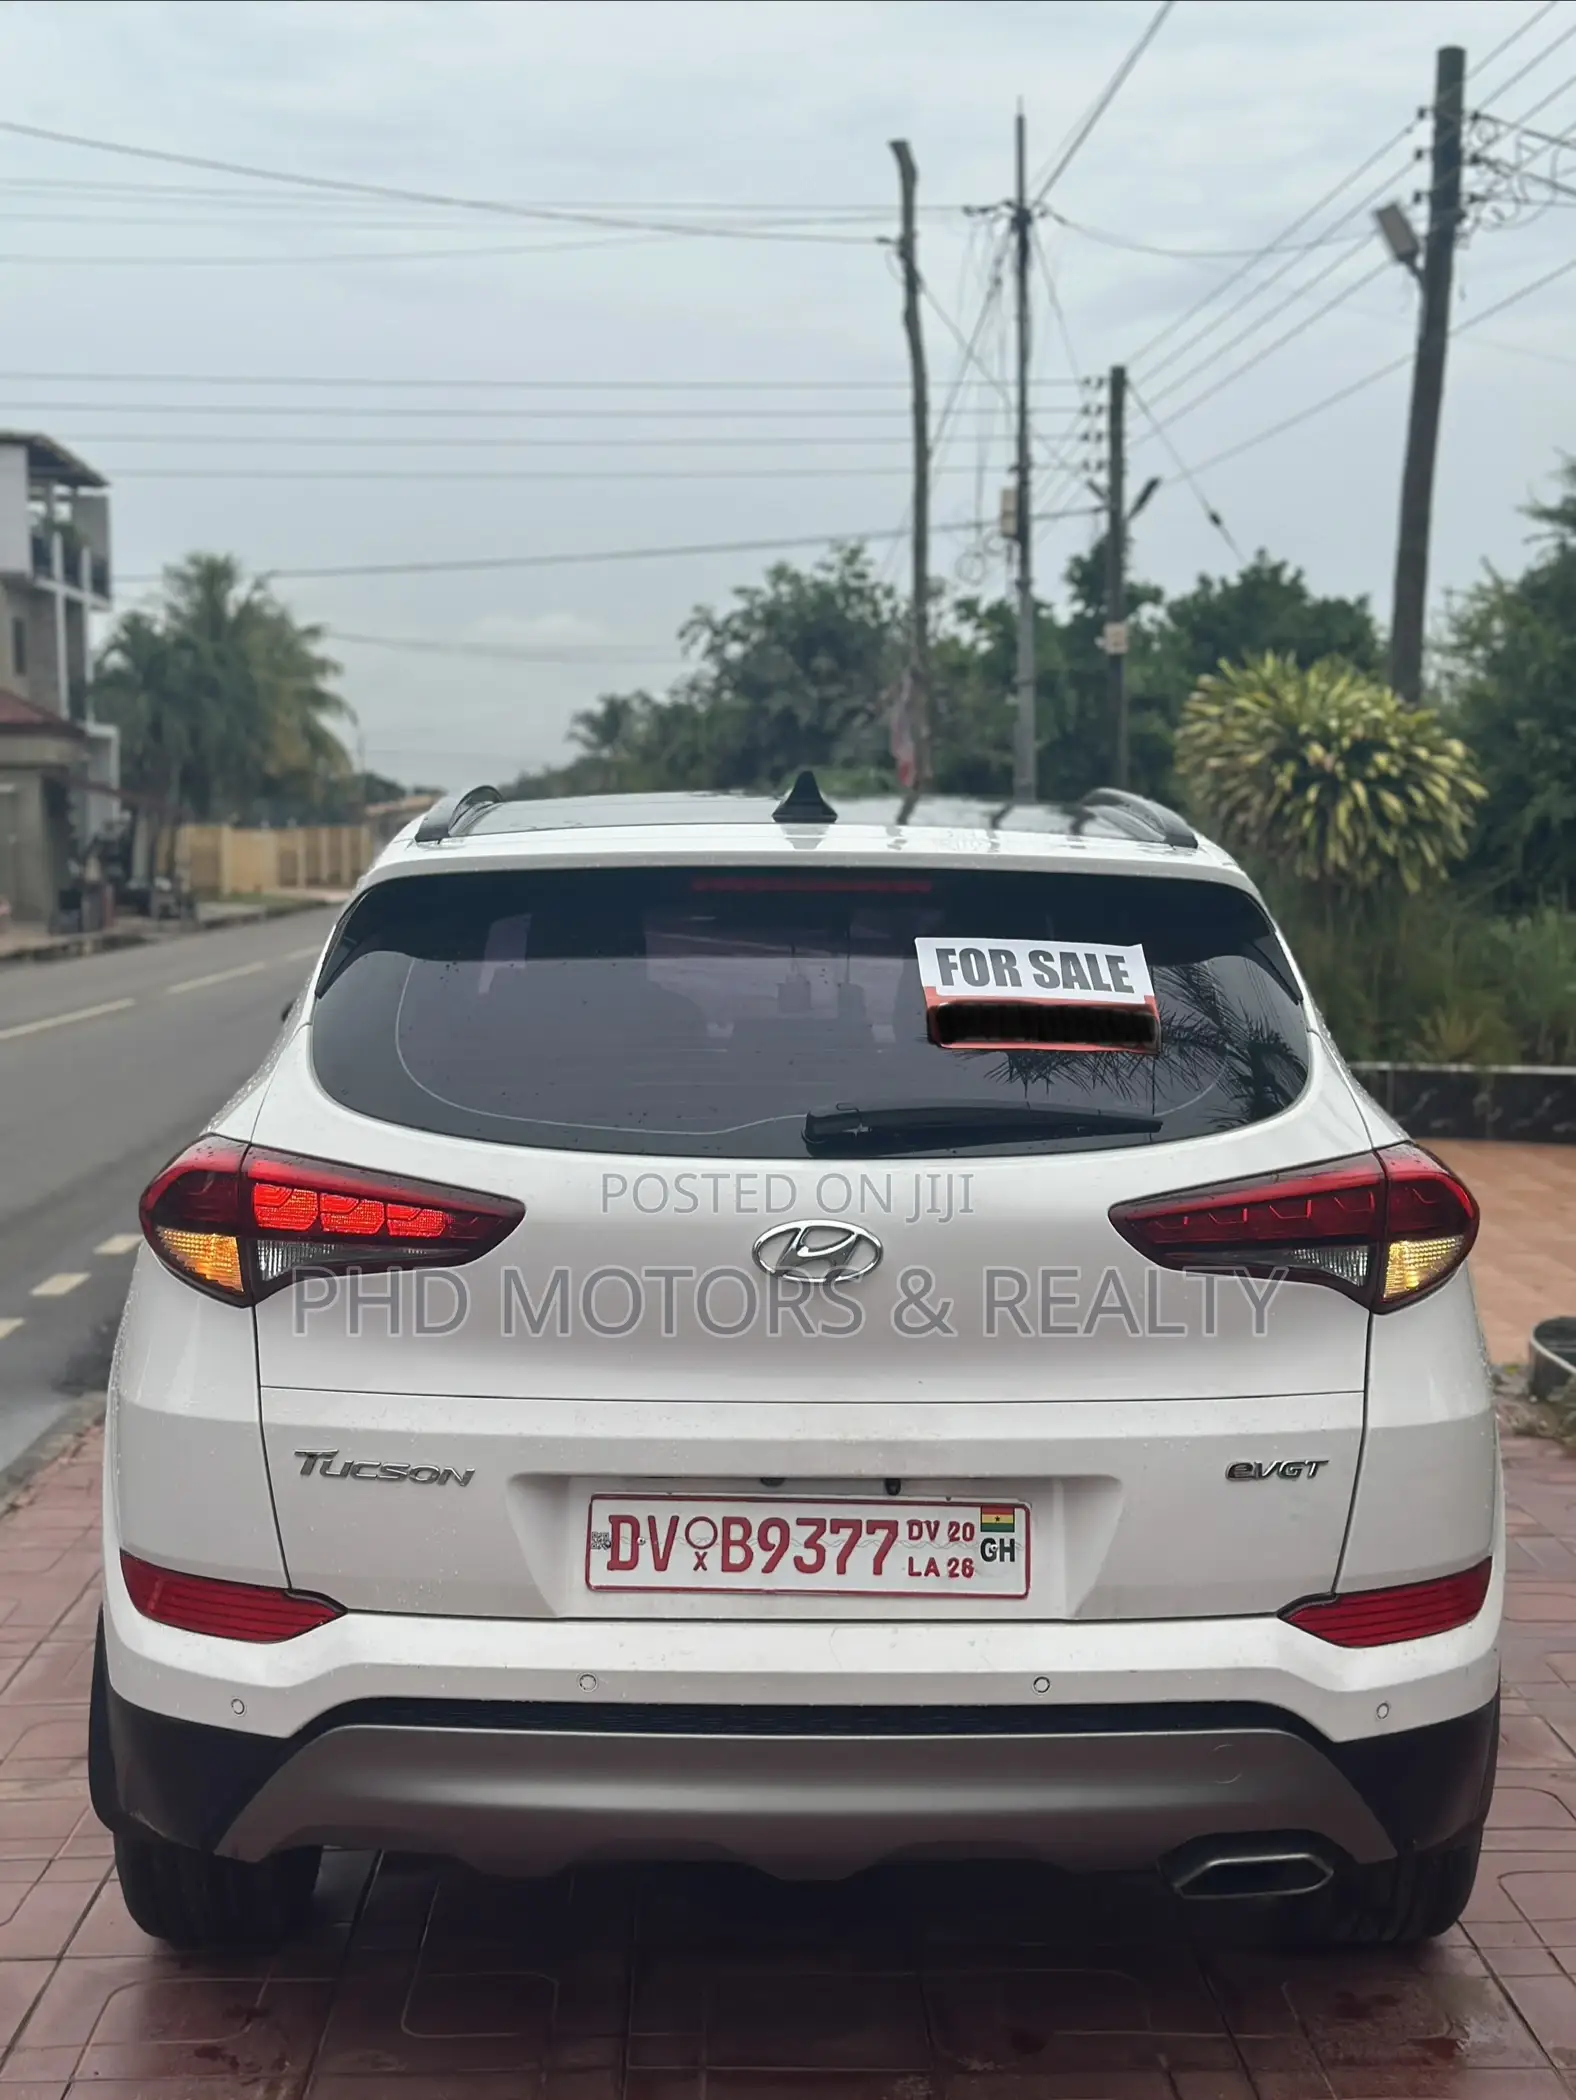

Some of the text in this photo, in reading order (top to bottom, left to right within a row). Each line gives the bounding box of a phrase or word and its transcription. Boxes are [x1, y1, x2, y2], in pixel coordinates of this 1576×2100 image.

[935, 948, 1135, 994] FOR SALE
[906, 1520, 976, 1542] DV 20
[607, 1514, 899, 1576] DV B9377
[980, 1537, 1016, 1563] GH
[907, 1556, 975, 1578] LA 26
